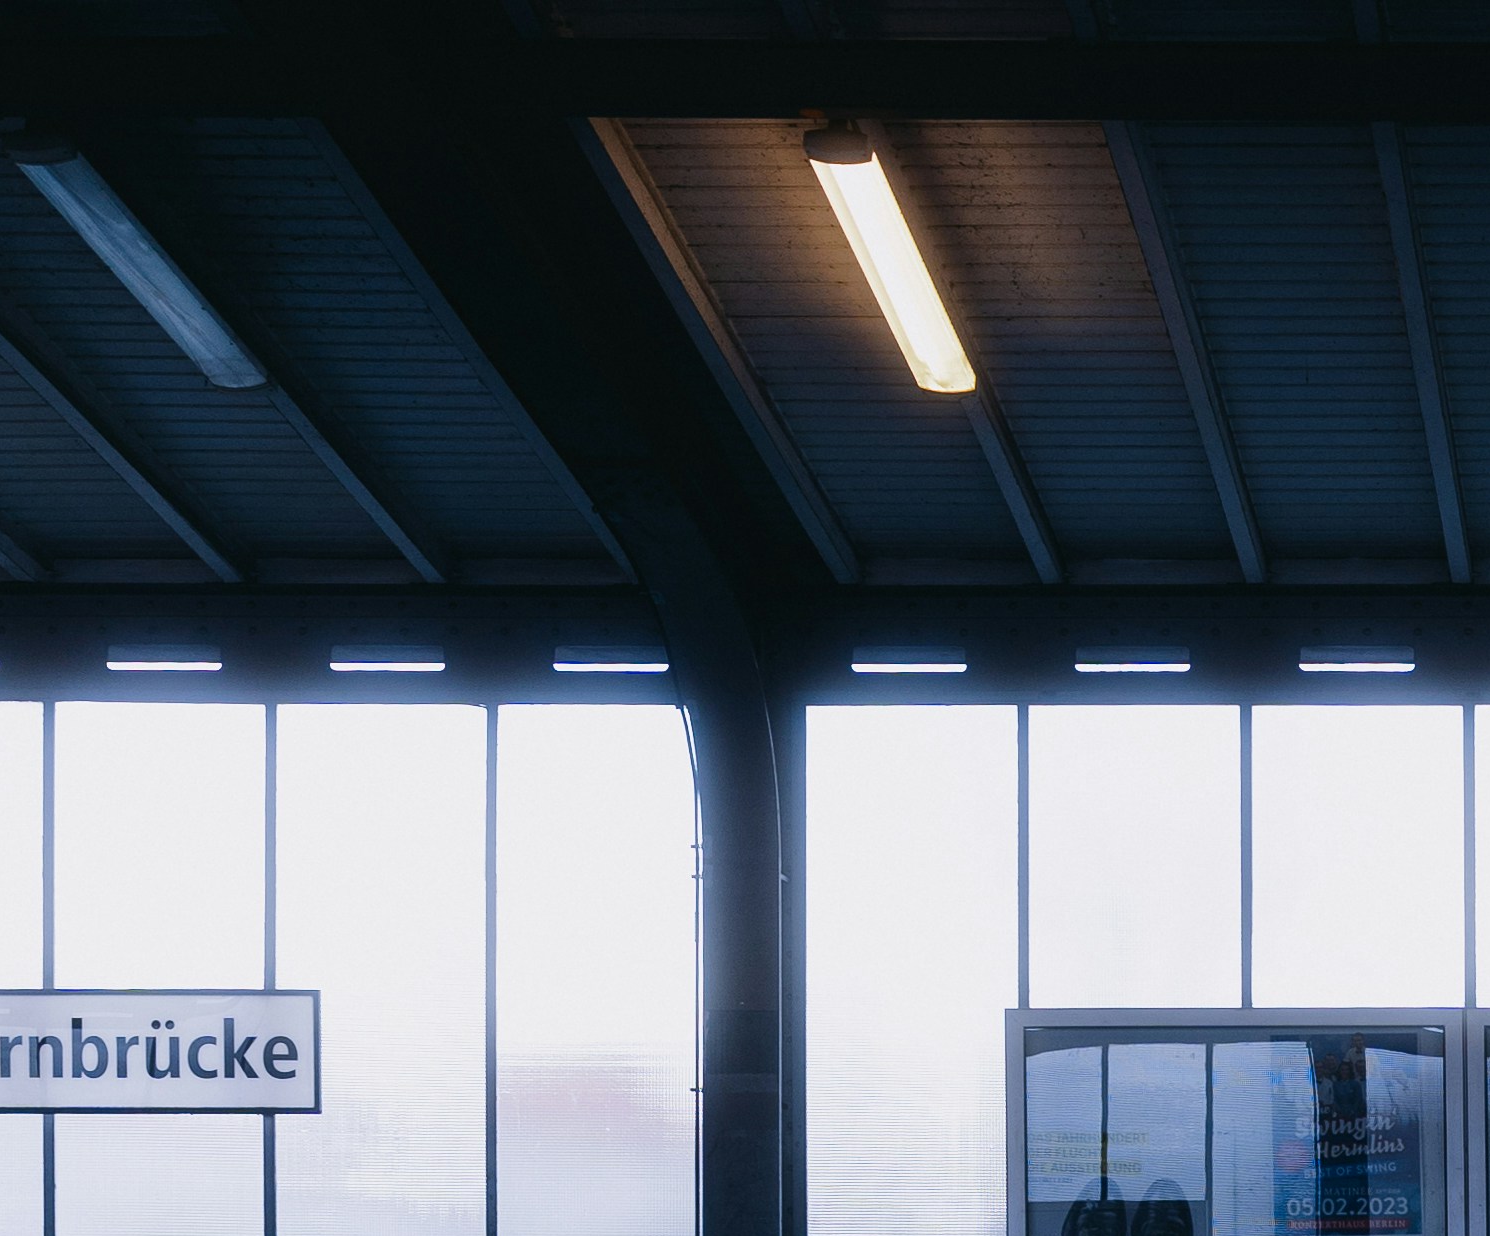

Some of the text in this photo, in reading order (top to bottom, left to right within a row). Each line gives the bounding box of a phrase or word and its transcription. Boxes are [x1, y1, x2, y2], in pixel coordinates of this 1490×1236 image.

[1056, 1132, 1149, 1144] JAHRHNDERT
[1055, 1147, 1107, 1158] FLUCH
[1050, 1162, 1142, 1173] AUSSTELUNG
[1335, 1166, 1354, 1177] OF
[1357, 1162, 1397, 1174] SWING
[1286, 1197, 1409, 1217] 05.02.2023
